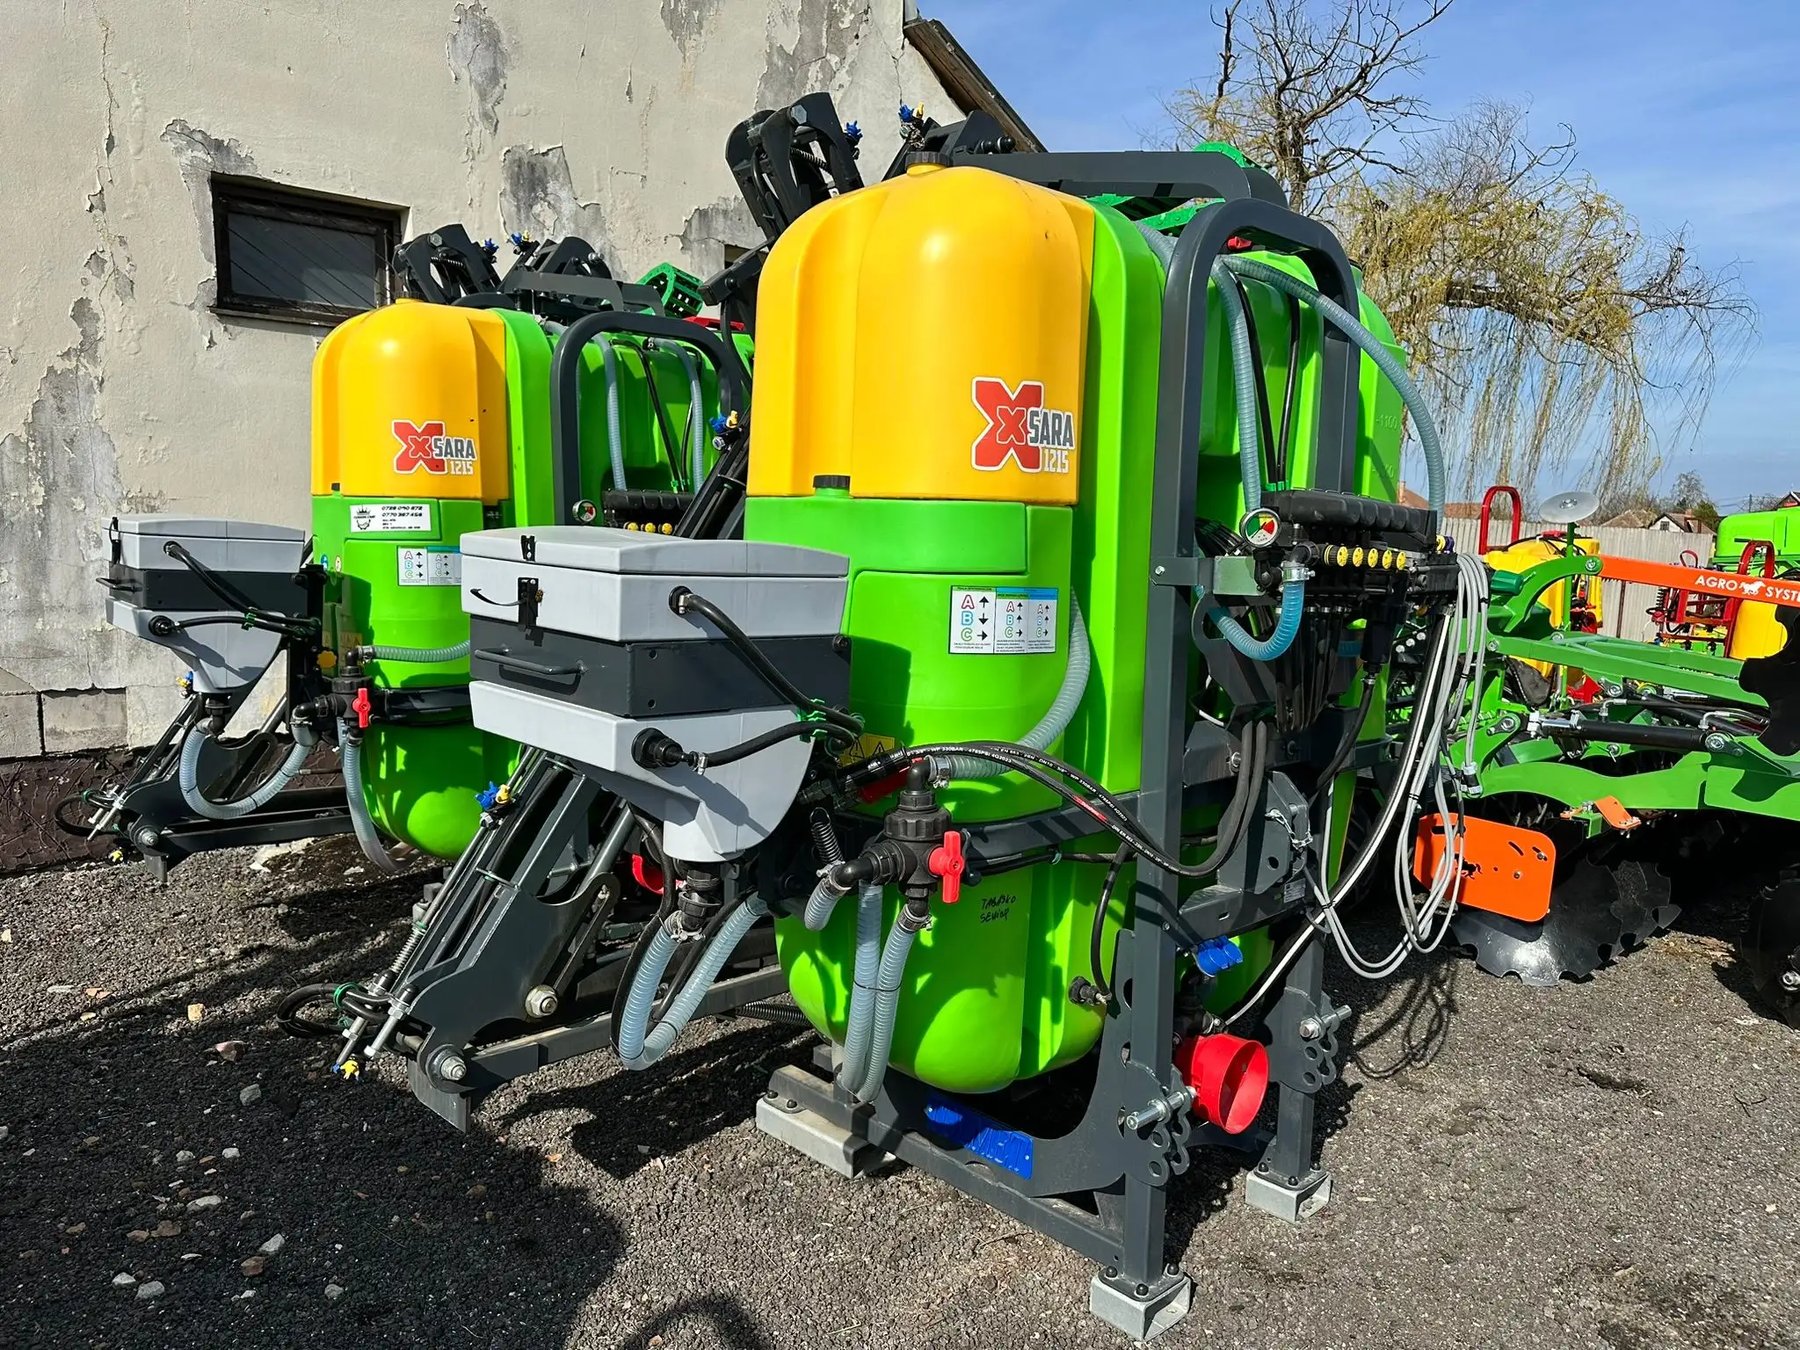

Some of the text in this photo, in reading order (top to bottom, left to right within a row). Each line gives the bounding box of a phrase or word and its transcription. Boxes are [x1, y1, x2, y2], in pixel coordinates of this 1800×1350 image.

[450, 460, 474, 475] 1215
[1044, 449, 1069, 473] 1215
[404, 550, 413, 560] A
[404, 560, 413, 570] B
[404, 570, 414, 579] C
[1695, 575, 1738, 591] AGRO
[961, 594, 975, 610] A
[1006, 601, 1015, 613] A
[961, 610, 974, 626] B
[1006, 614, 1014, 626] B
[960, 627, 973, 642] C
[1005, 626, 1014, 639] C
